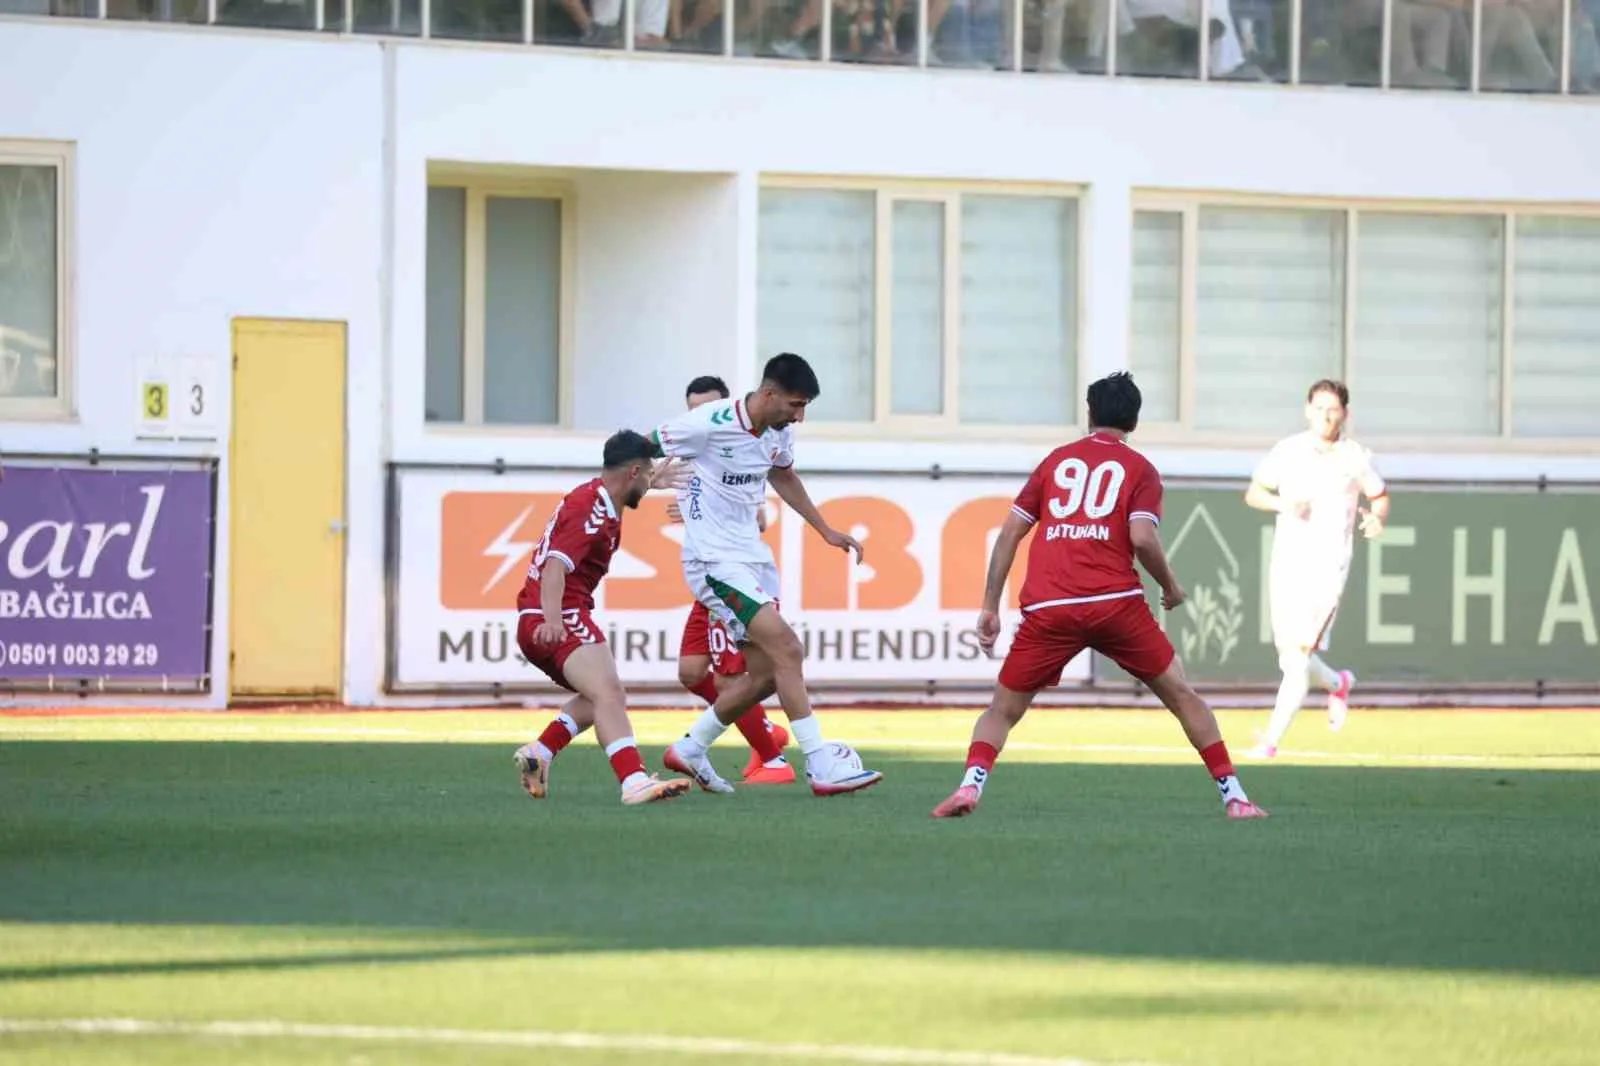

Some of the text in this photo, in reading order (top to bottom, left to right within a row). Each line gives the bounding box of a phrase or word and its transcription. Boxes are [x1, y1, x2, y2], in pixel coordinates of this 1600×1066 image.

[149, 386, 163, 417] 3
[191, 384, 204, 415] 3
[1048, 457, 1126, 519] 90
[0, 485, 165, 580] arl
[1046, 523, 1110, 541] BATUHAN
[0, 583, 152, 619] BAĞLICA
[9, 643, 158, 666] 0501 003 29 29
